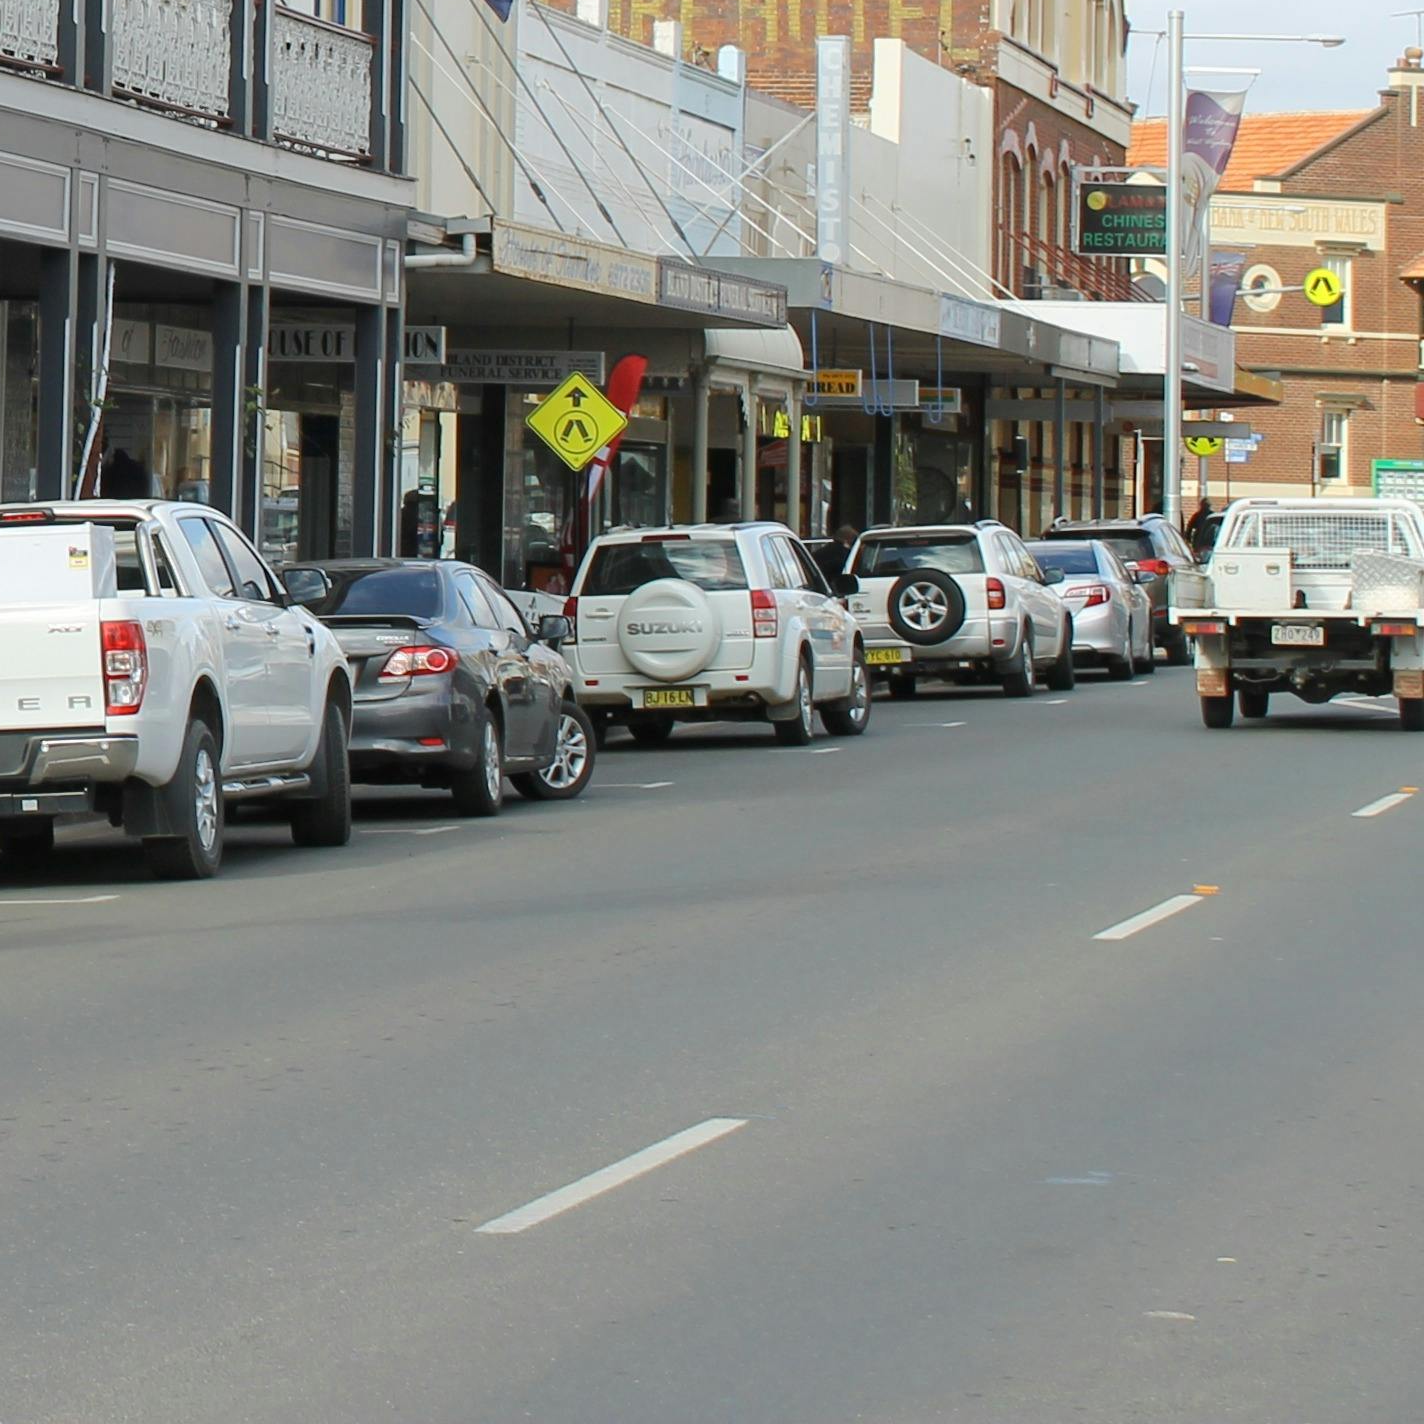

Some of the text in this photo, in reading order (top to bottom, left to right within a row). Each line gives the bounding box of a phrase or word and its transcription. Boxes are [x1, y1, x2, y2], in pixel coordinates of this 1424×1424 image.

[1102, 214, 1166, 229] CHINES
[1334, 208, 1378, 235] WALES
[267, 329, 315, 357] OUSE
[320, 329, 345, 357] OF
[496, 355, 557, 368] DISTRICT
[440, 366, 505, 378] FUNERAL
[806, 381, 855, 394] BREAD
[626, 620, 703, 636] SUZUKI
